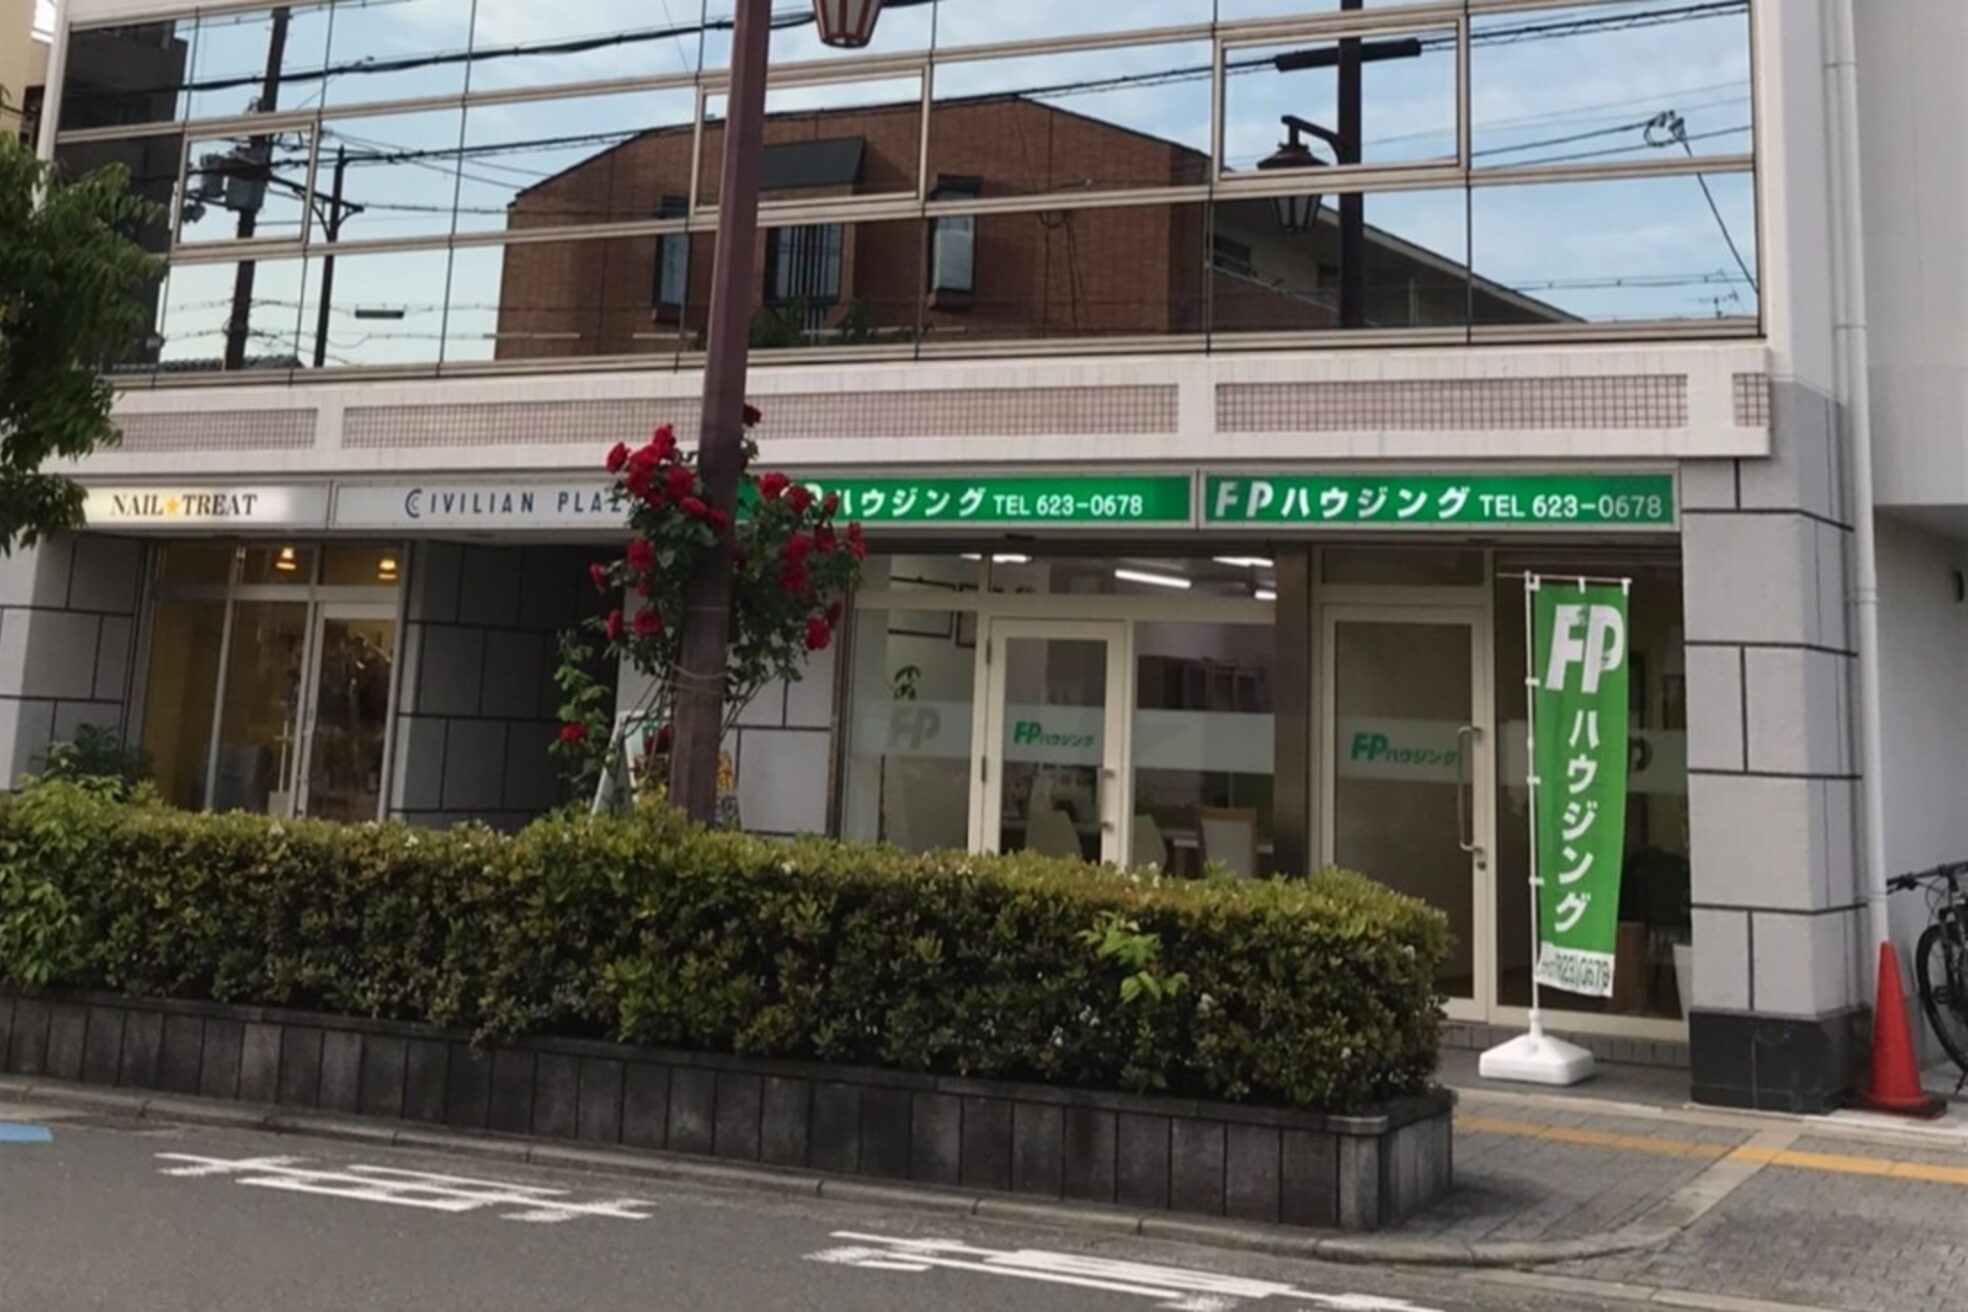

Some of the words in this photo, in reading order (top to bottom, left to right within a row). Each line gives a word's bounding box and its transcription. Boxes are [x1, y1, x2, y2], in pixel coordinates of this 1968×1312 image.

[112, 494, 164, 516] NAIL
[182, 494, 257, 516] TREAT
[556, 491, 622, 513] PLAZ
[994, 494, 1031, 516] TEL
[1036, 494, 1143, 517] 623-0678
[1214, 481, 1470, 519] FPハウジング
[1479, 494, 1526, 517] TEL
[1532, 494, 1662, 518] 623-0678
[1545, 603, 1625, 694] FP
[1554, 709, 1600, 933] ハウジング
